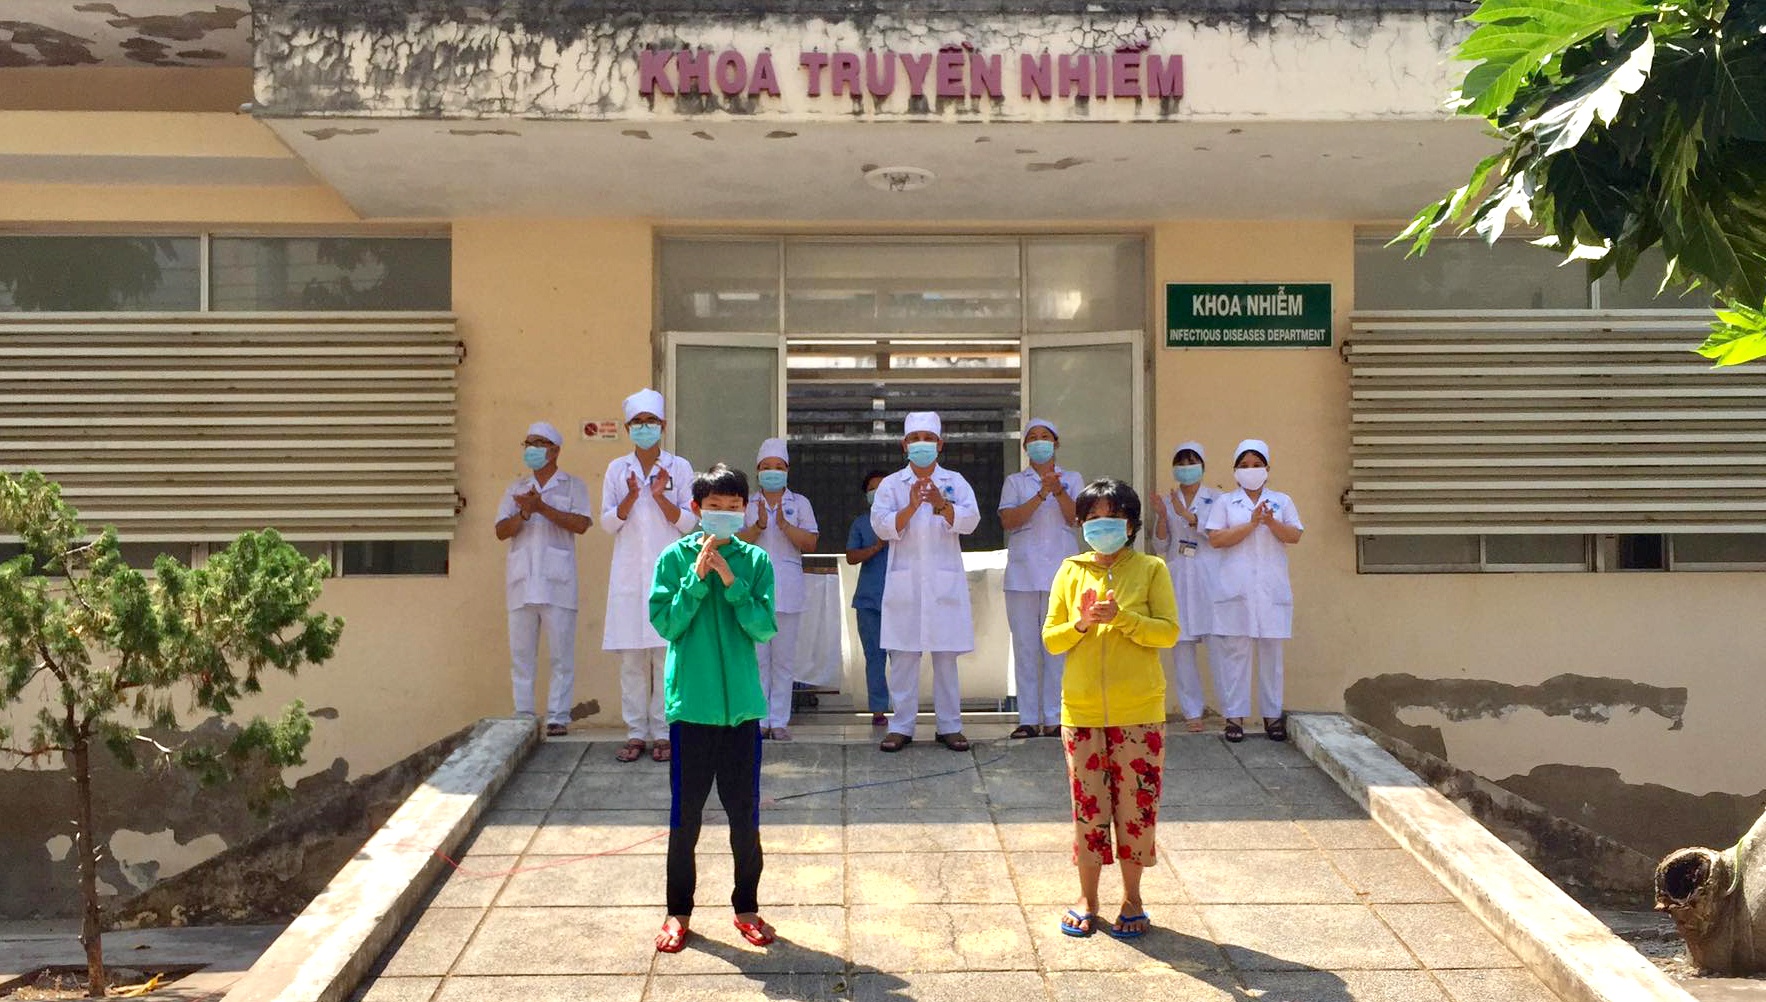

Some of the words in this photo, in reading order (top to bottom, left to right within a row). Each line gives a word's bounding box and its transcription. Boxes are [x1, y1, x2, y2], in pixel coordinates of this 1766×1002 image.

[639, 49, 781, 97] KHOA
[800, 41, 1003, 98] TRUYỀN
[1192, 294, 1242, 316] KHOA
[1246, 286, 1303, 316] NHIỄM
[1169, 328, 1221, 342] INFECTIOUS
[1223, 328, 1266, 342] DISEASES
[1267, 328, 1326, 342] DEPARTMENT
